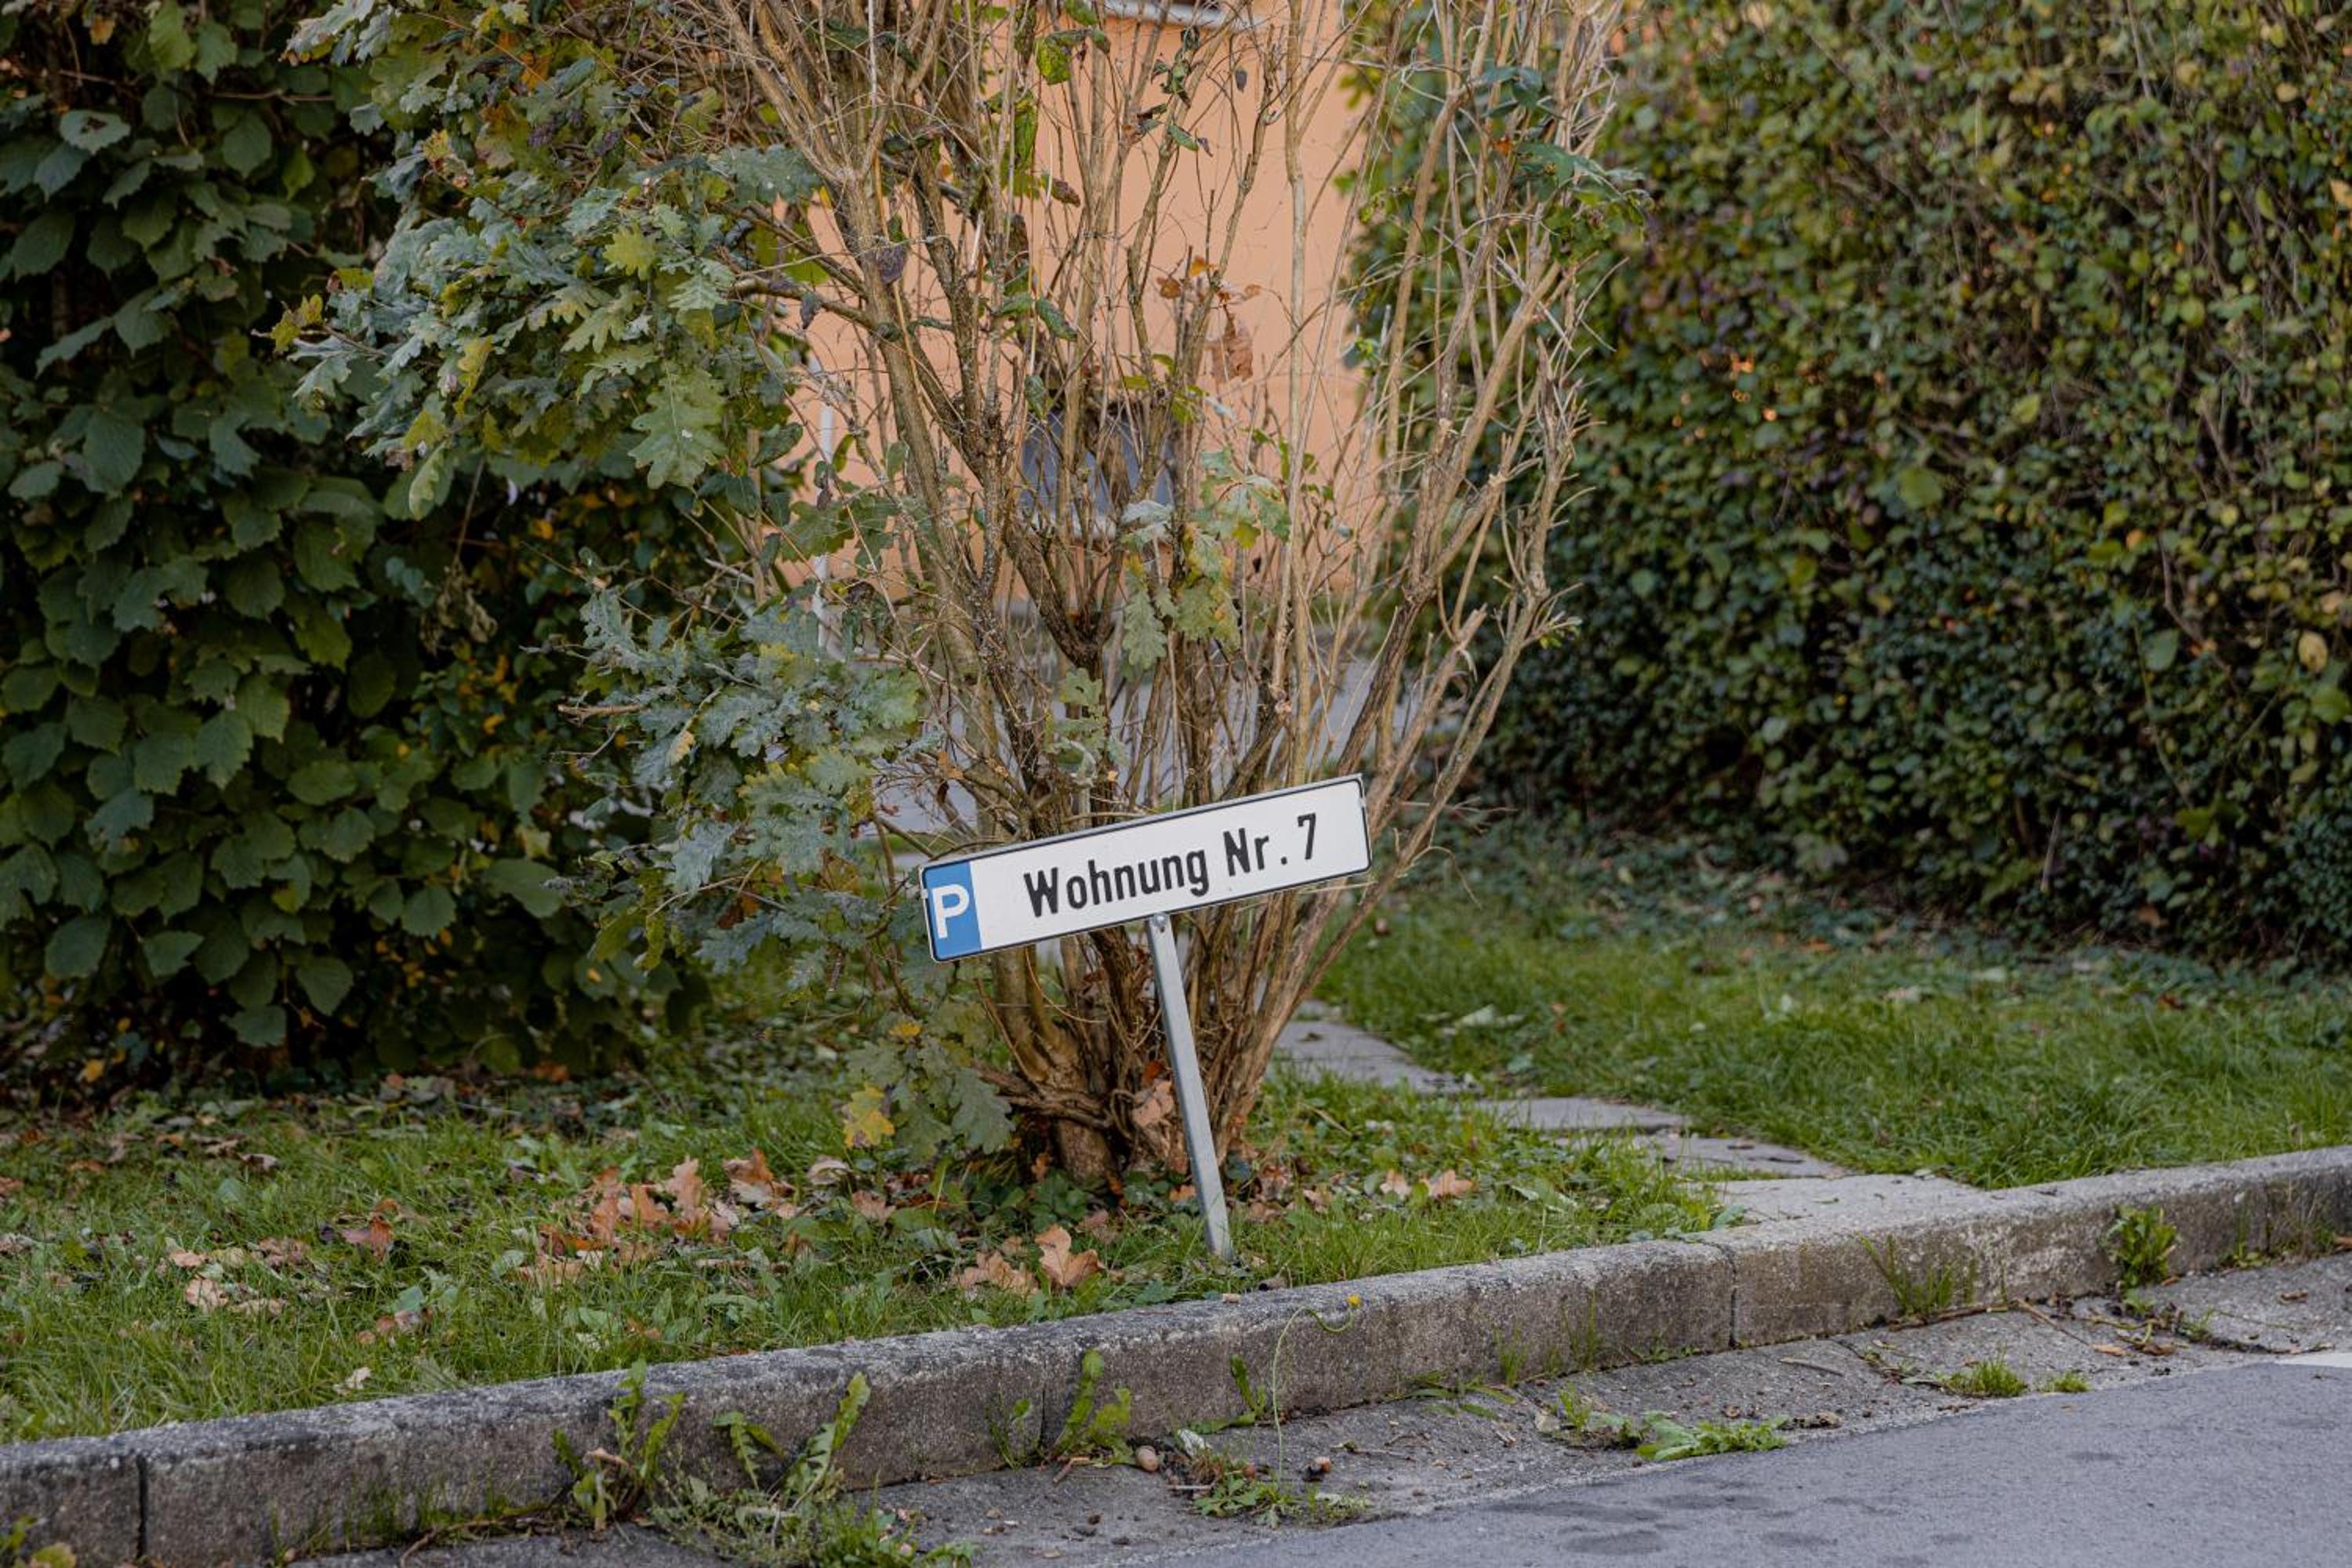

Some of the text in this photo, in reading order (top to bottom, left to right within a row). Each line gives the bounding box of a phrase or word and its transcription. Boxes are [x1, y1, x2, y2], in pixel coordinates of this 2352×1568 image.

[1023, 849, 1209, 917] Wohnung
[1298, 813, 1317, 860] 7
[931, 883, 970, 938] P
